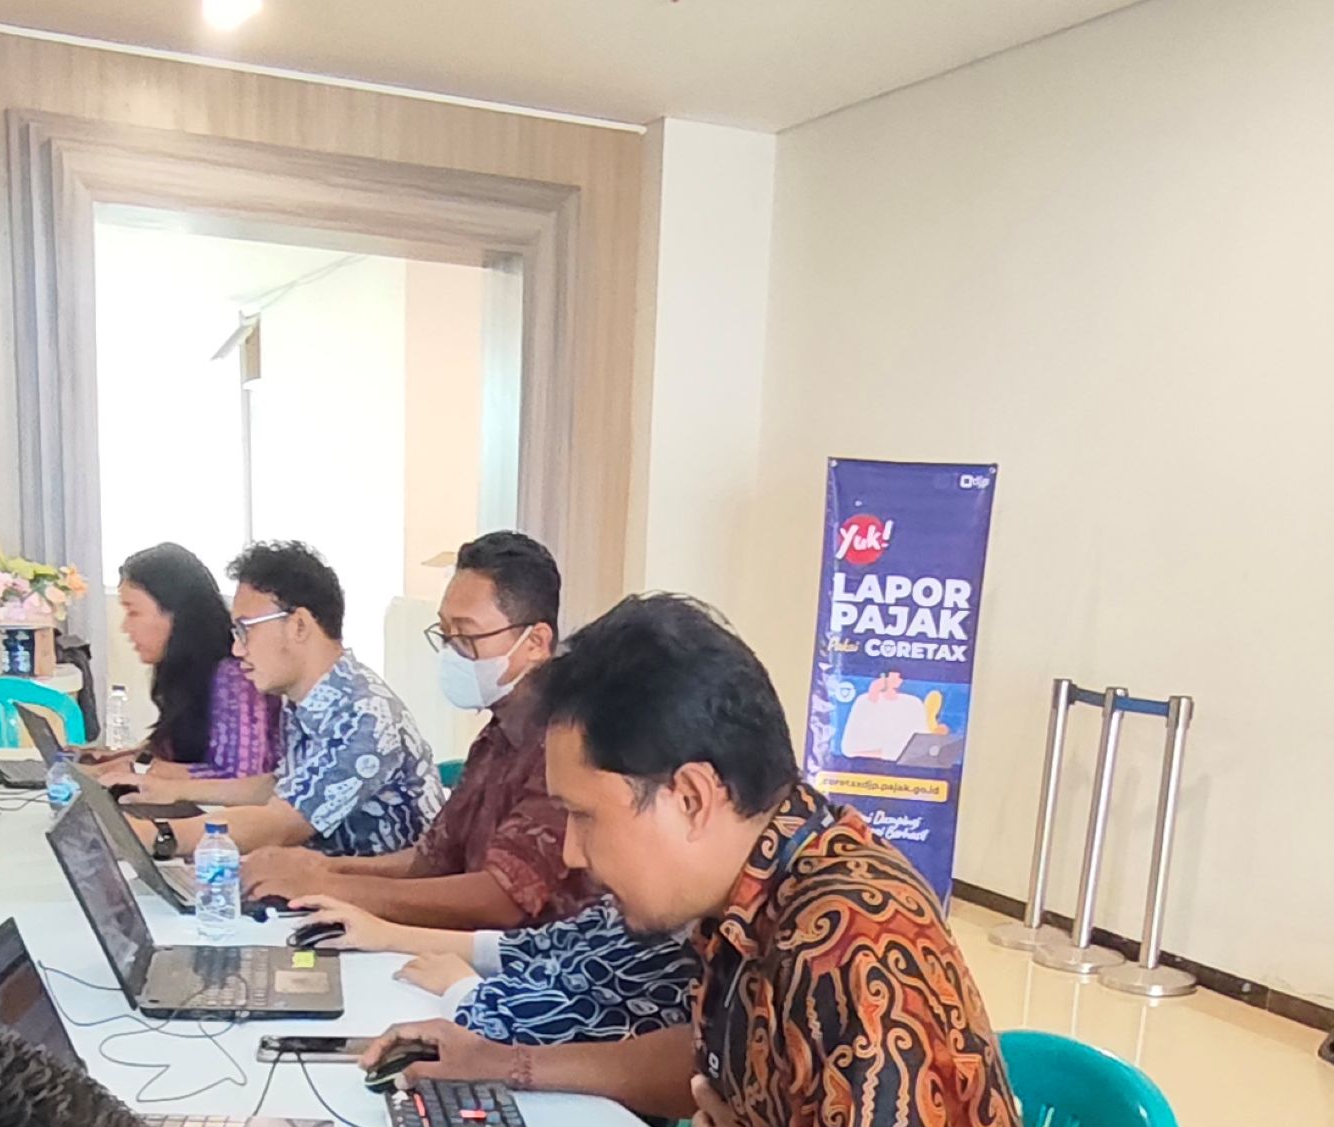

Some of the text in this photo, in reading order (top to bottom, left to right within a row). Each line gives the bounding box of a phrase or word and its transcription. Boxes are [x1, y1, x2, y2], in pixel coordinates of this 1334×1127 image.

[835, 519, 894, 560] Yuk!
[833, 572, 972, 608] LAPOR
[830, 602, 971, 640] PAJAK
[865, 638, 967, 662] CORETAX
